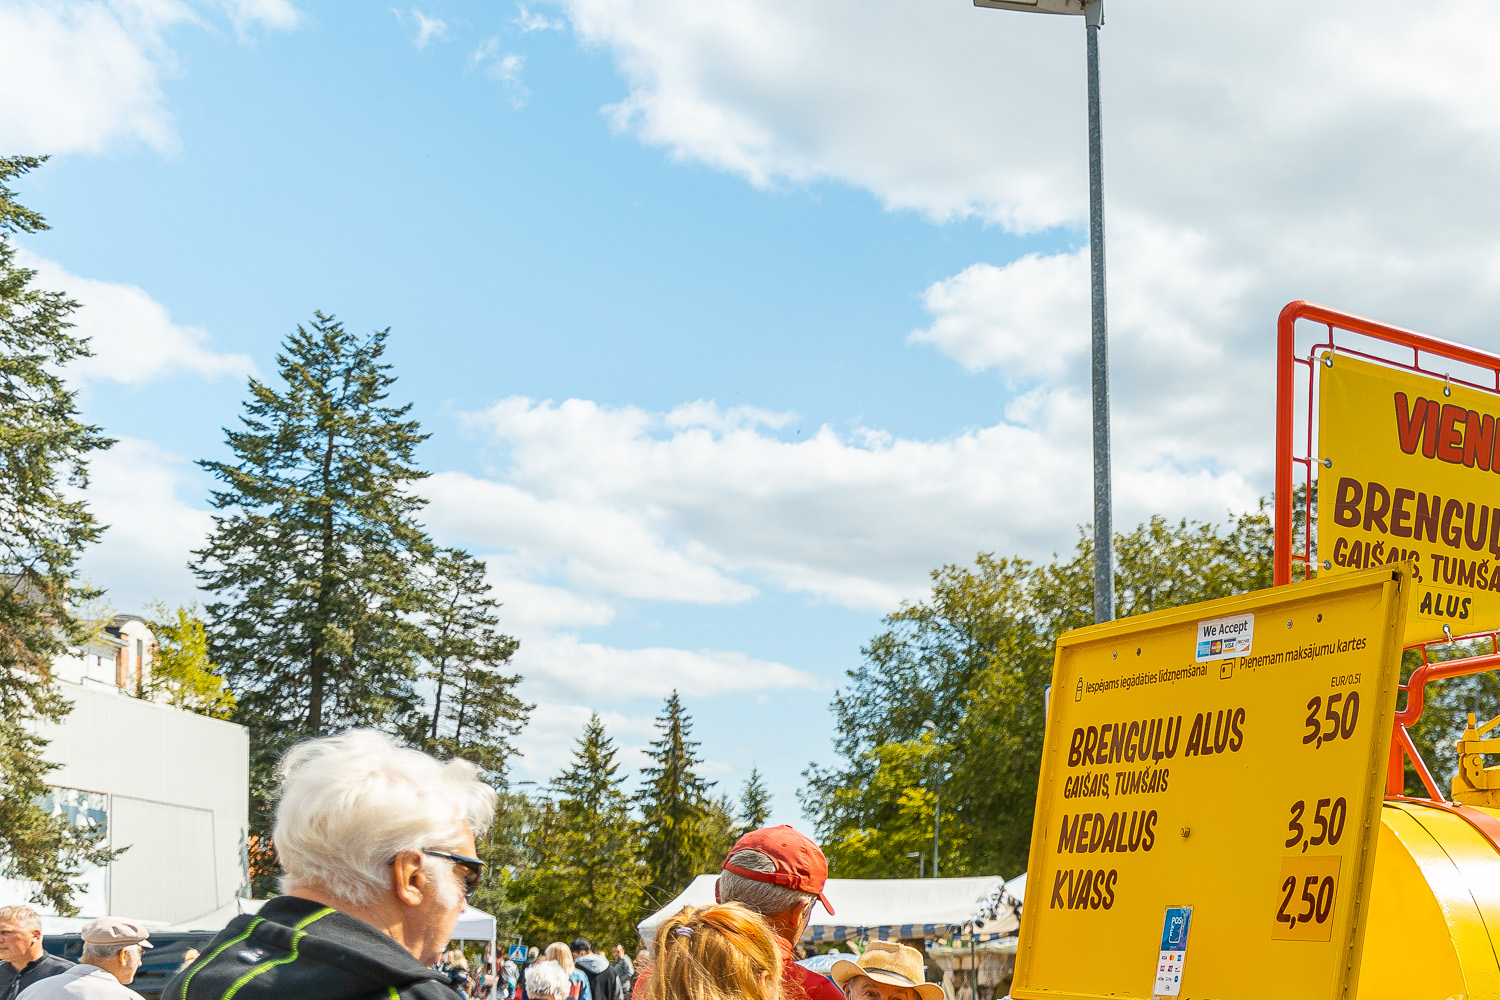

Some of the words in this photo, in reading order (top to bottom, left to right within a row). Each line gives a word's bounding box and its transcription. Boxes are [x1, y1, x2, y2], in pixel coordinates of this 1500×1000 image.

[1419, 591, 1471, 619] ALUS
[1203, 625, 1217, 637] We
[1218, 620, 1248, 634] Accept
[1240, 652, 1284, 672] Pieņemam
[1285, 643, 1335, 663] maksājumu
[1336, 637, 1366, 653] kartes
[1085, 679, 1119, 694] Iespējams
[1120, 671, 1157, 690] iegādāties
[1067, 715, 1182, 767] BRENGUĻU
[1184, 707, 1245, 757] ALUS
[1302, 691, 1360, 750] 3,50
[1064, 771, 1110, 799] GAIŠAIS,
[1114, 766, 1170, 796] TUMŠAIS
[1057, 810, 1158, 854] MEDALUS
[1285, 797, 1347, 853] 3,50
[1050, 869, 1118, 910] KVASS
[1276, 875, 1335, 929] 2,50
